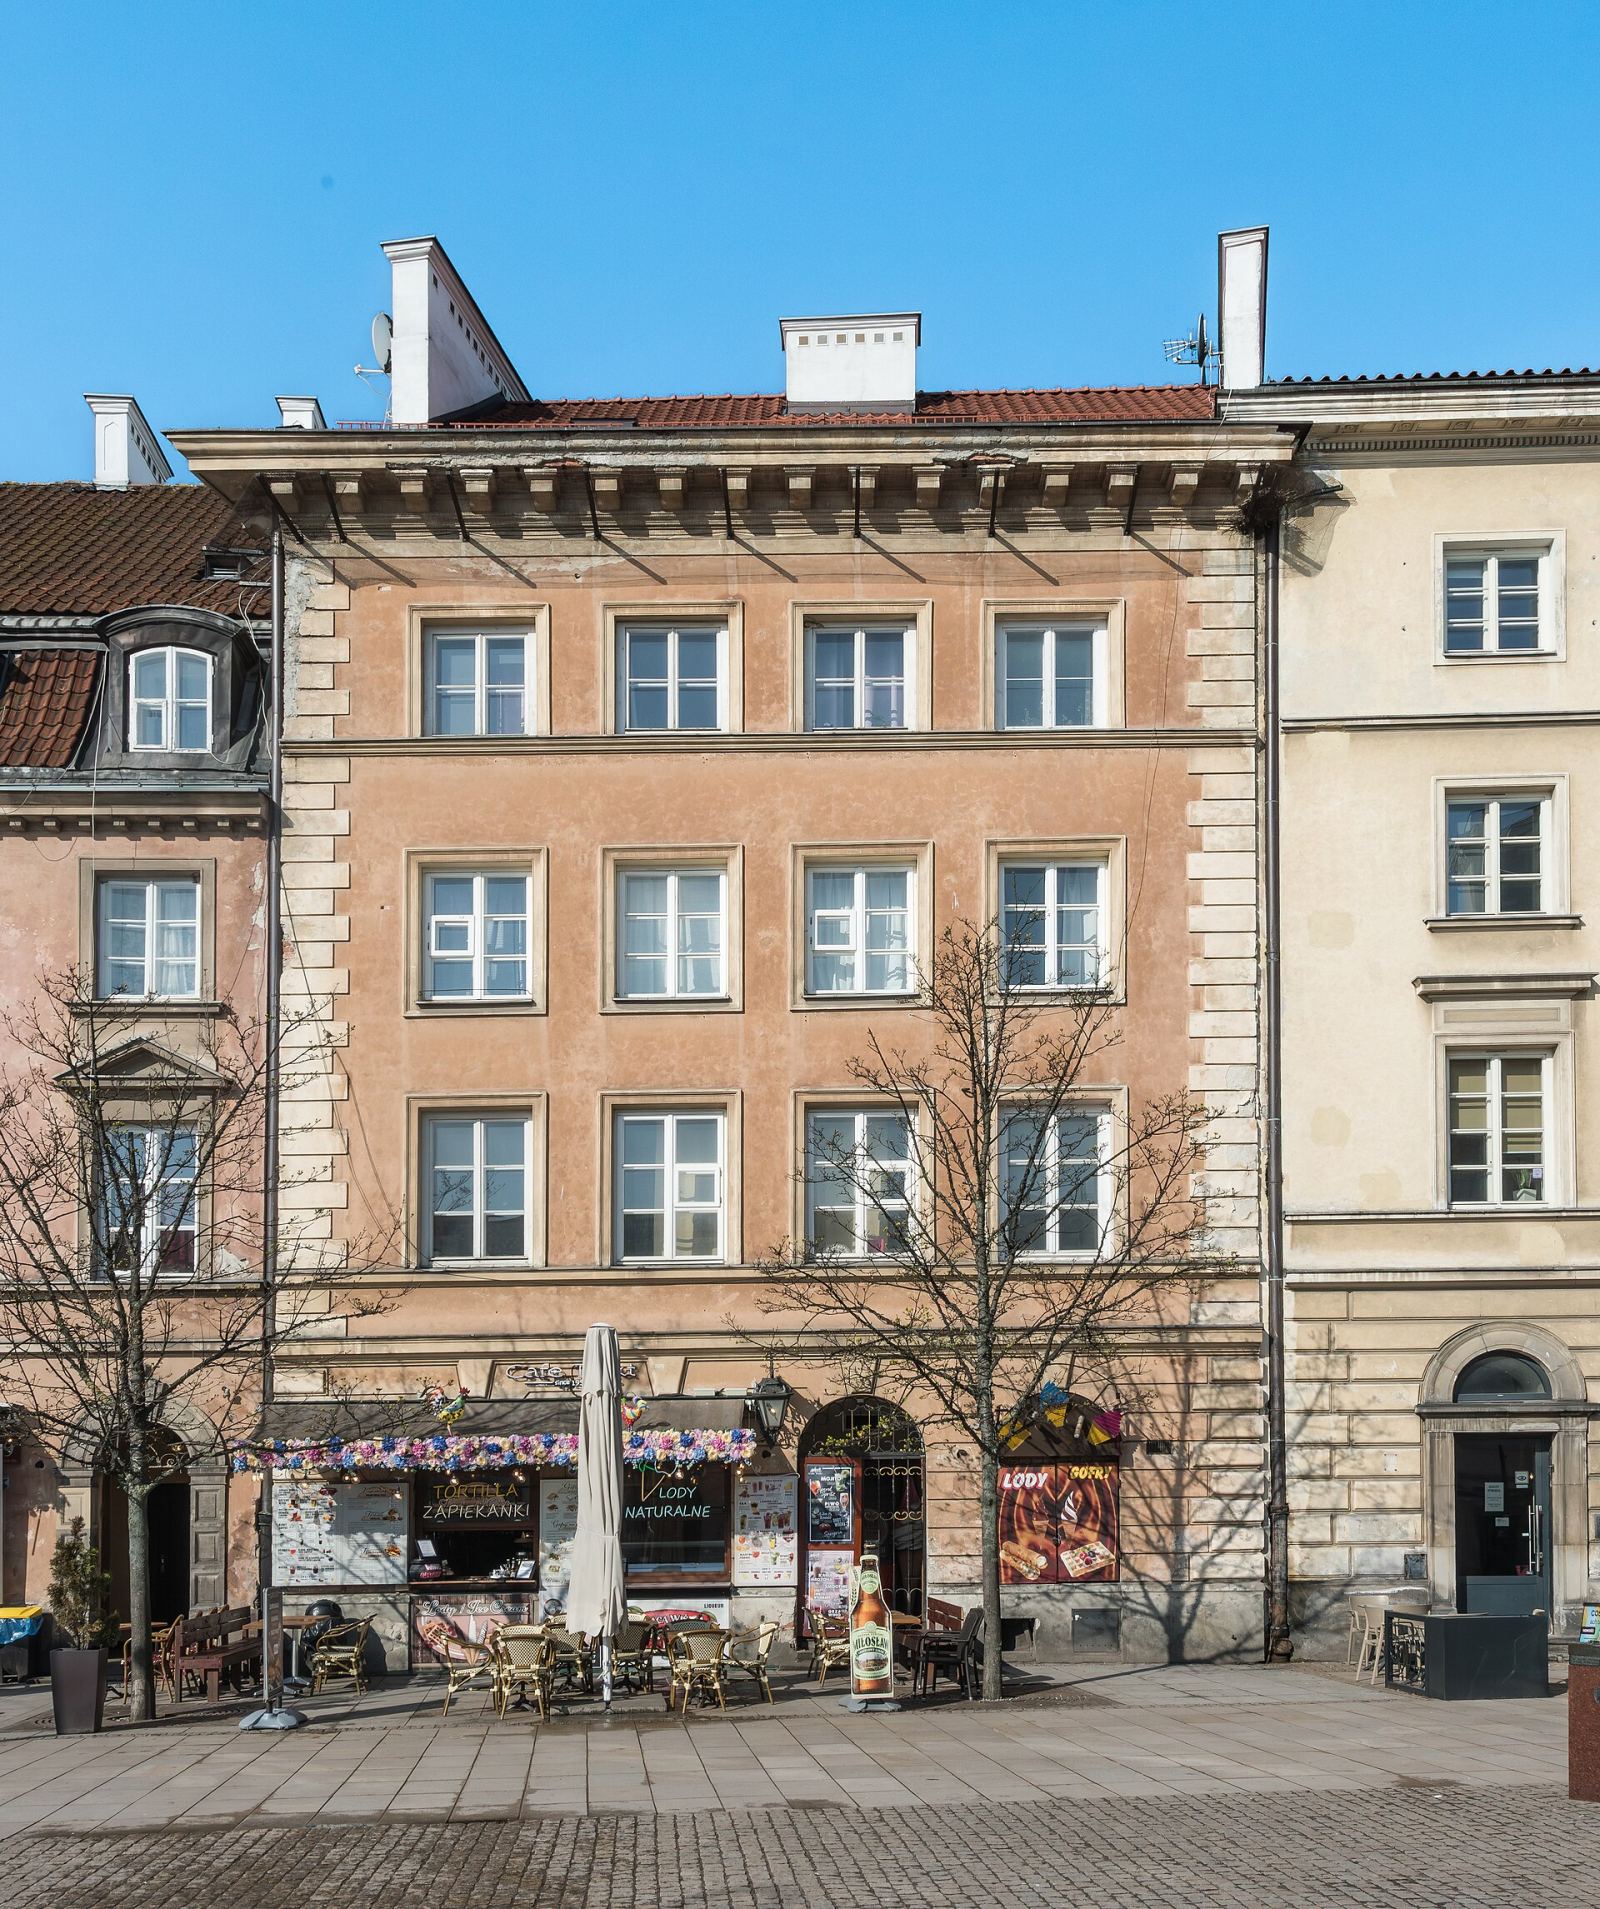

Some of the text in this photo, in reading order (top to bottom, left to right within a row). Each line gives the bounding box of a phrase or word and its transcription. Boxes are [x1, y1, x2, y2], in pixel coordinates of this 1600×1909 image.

[506, 1363, 562, 1379] Cafe
[1003, 1472, 1048, 1488] LODY
[433, 1483, 518, 1499] TORTILLA
[659, 1487, 697, 1499] LODY
[422, 1504, 530, 1519] ZAPIEKANKI
[625, 1505, 711, 1518] NATURALNE
[421, 1599, 458, 1618] Lody
